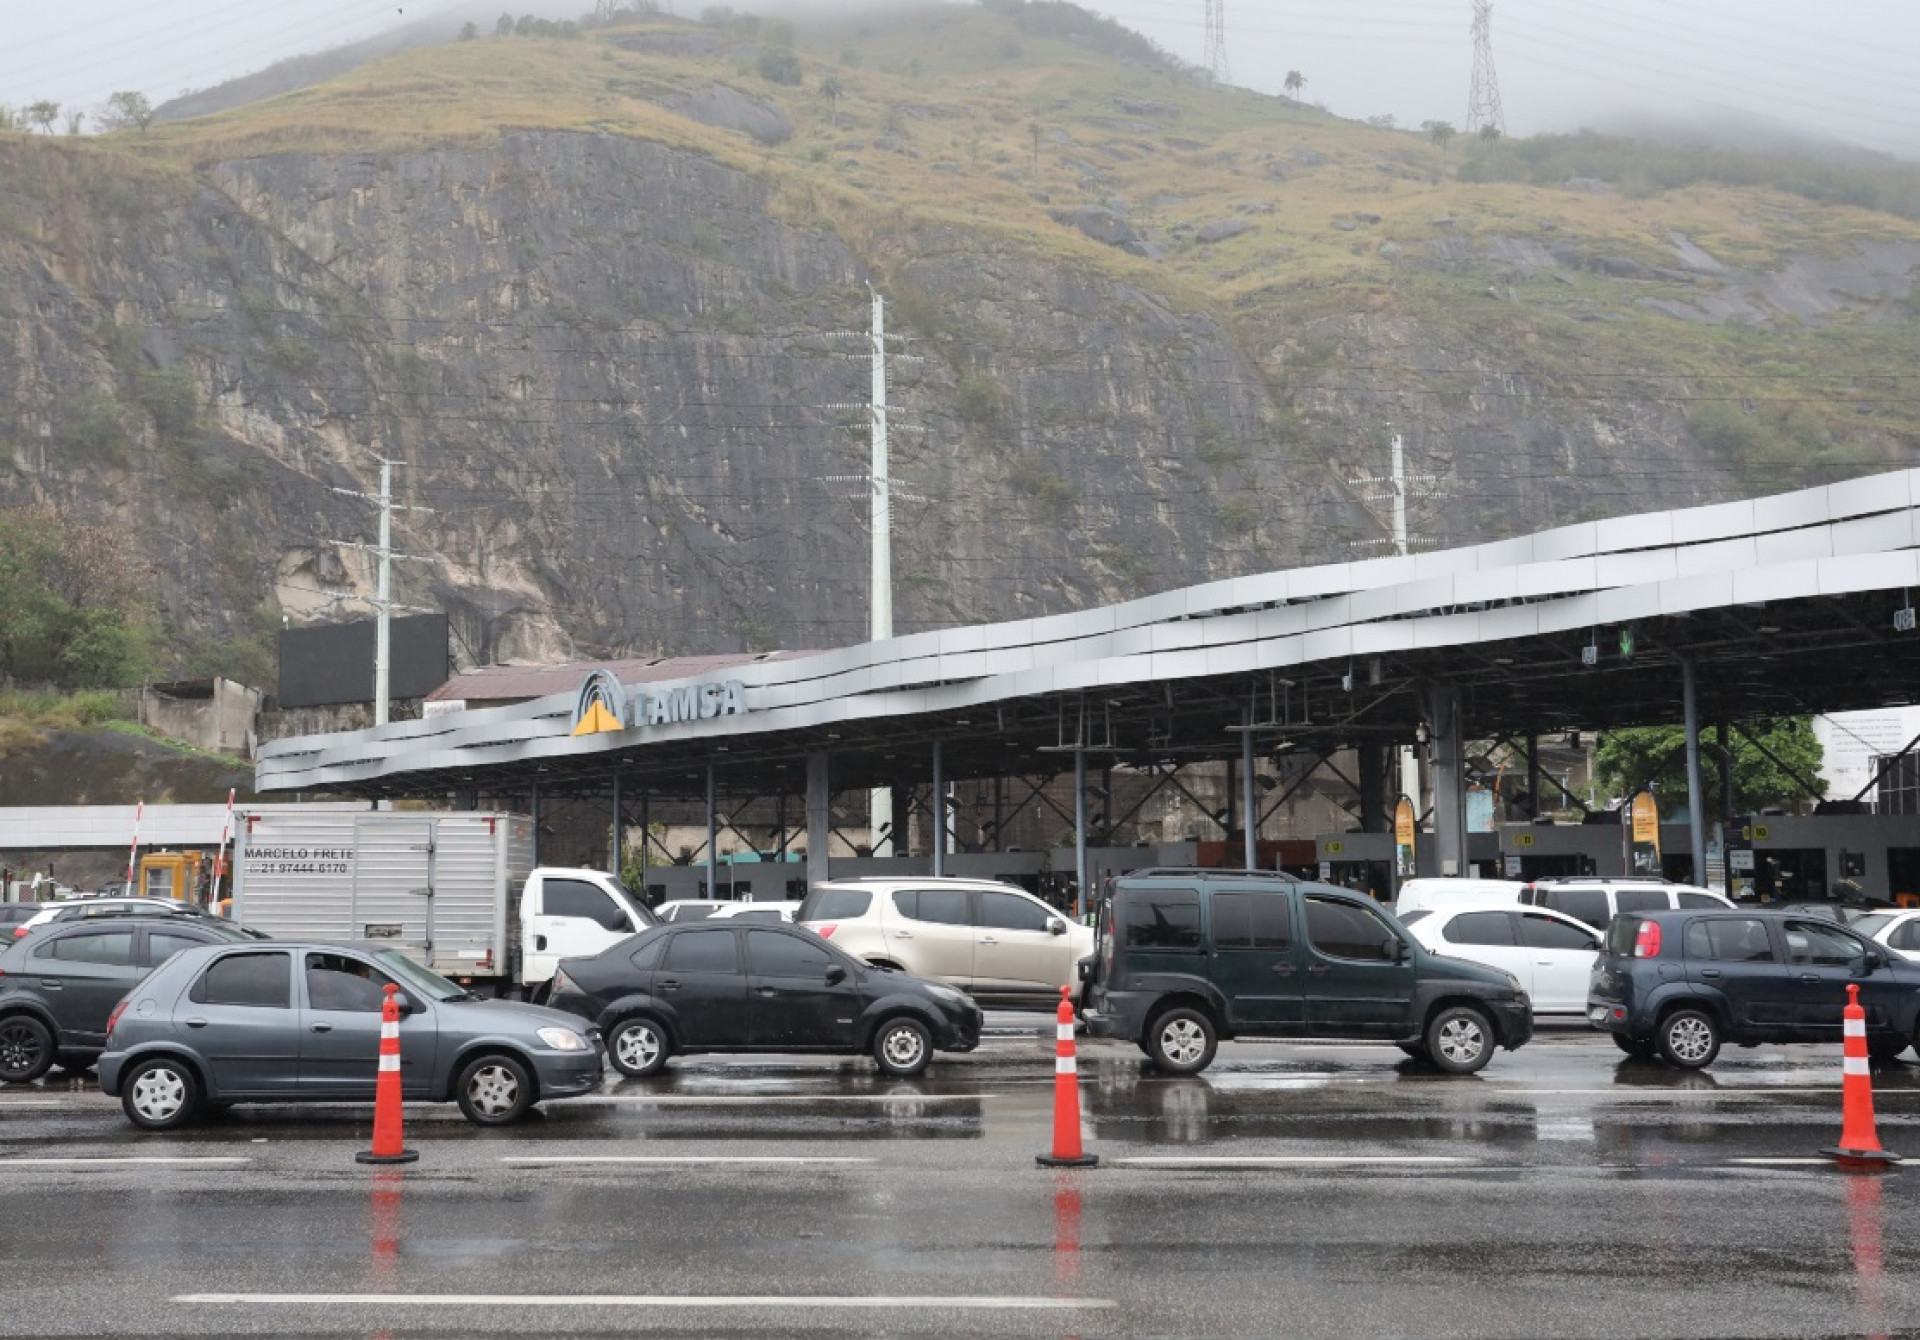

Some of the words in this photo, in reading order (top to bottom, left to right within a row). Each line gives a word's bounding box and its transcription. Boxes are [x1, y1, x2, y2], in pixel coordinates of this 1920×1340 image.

[634, 680, 747, 727] LAMSA
[244, 848, 308, 859] MARCELO
[313, 848, 354, 860] FRETE
[261, 863, 275, 873] 21
